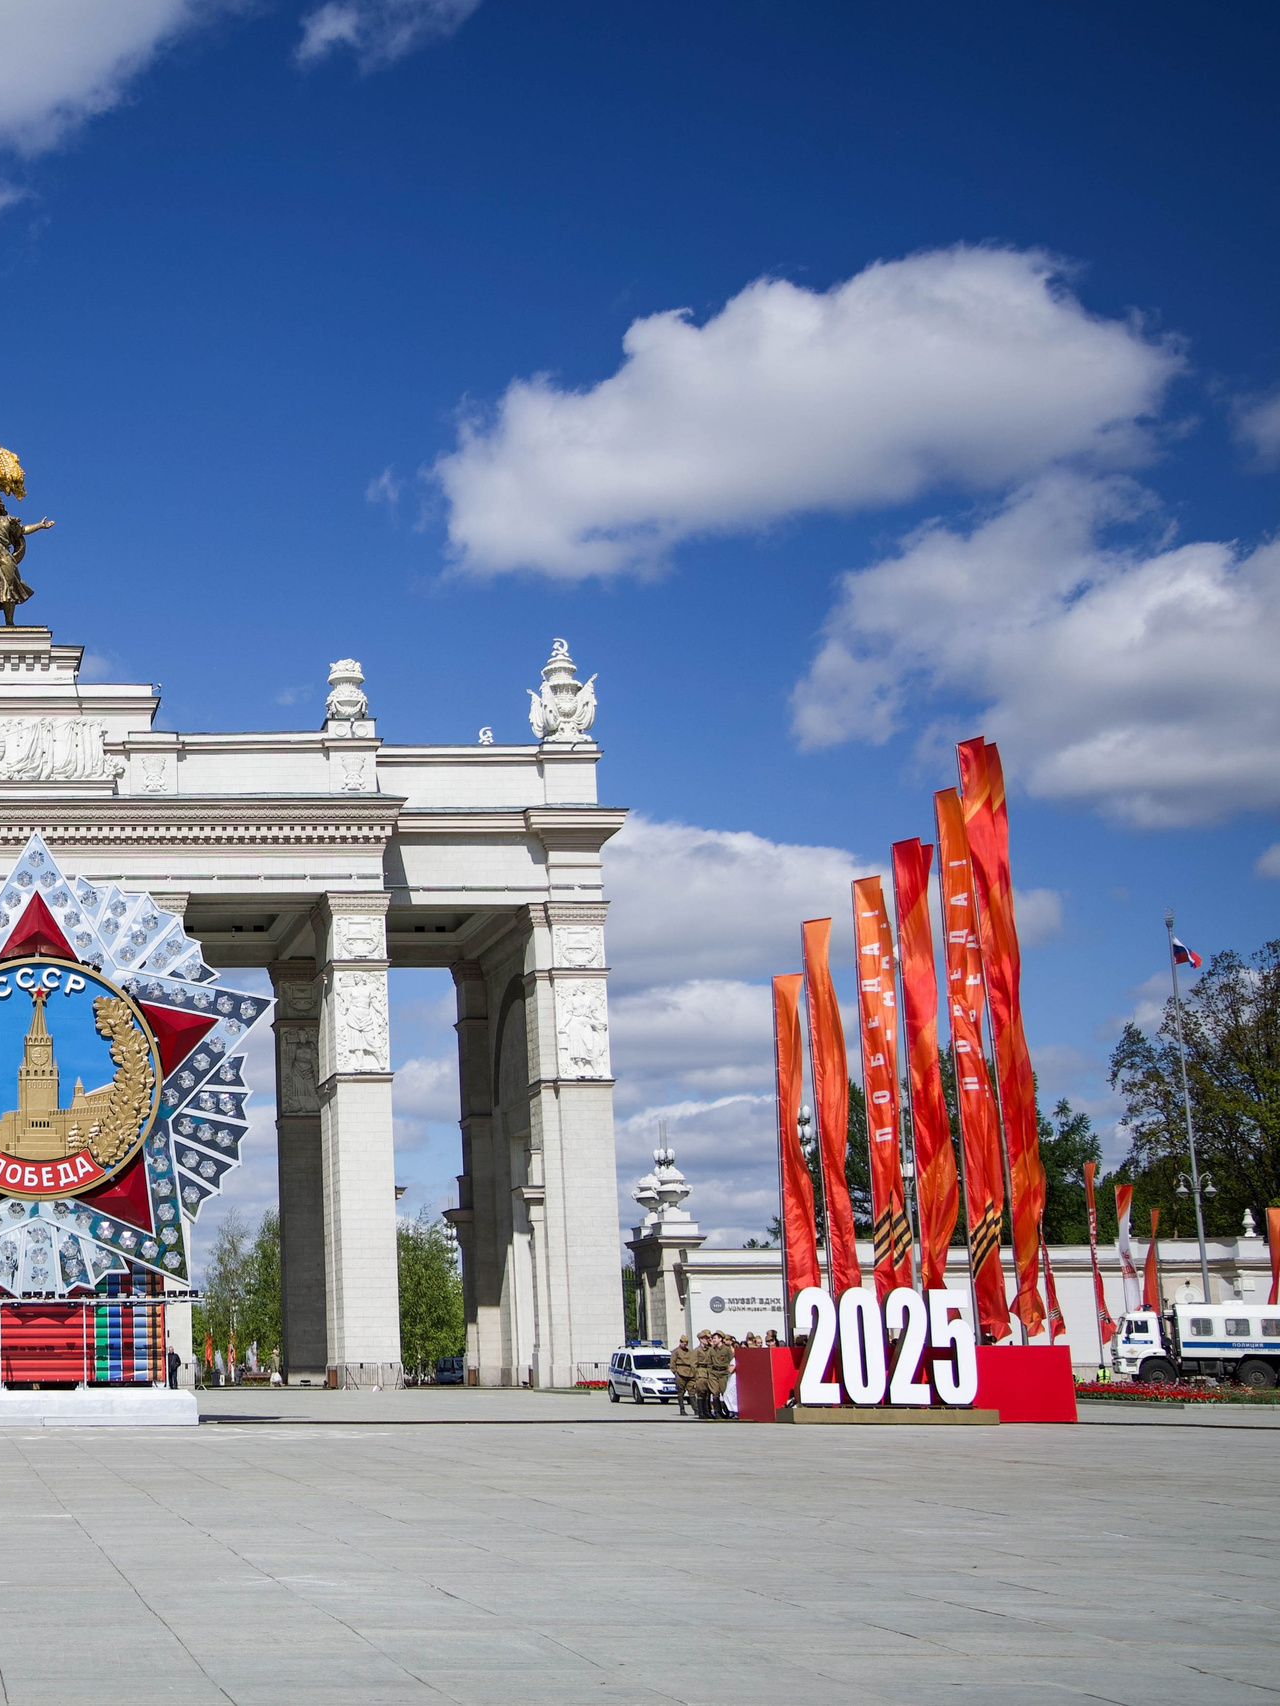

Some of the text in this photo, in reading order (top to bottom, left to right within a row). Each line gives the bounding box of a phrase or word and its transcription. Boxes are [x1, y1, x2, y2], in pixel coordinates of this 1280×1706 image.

[861, 909, 892, 1142] ПОБЕДА!
[728, 1297, 756, 1305] МУЗЕЙ
[795, 1286, 978, 1405] 2025
